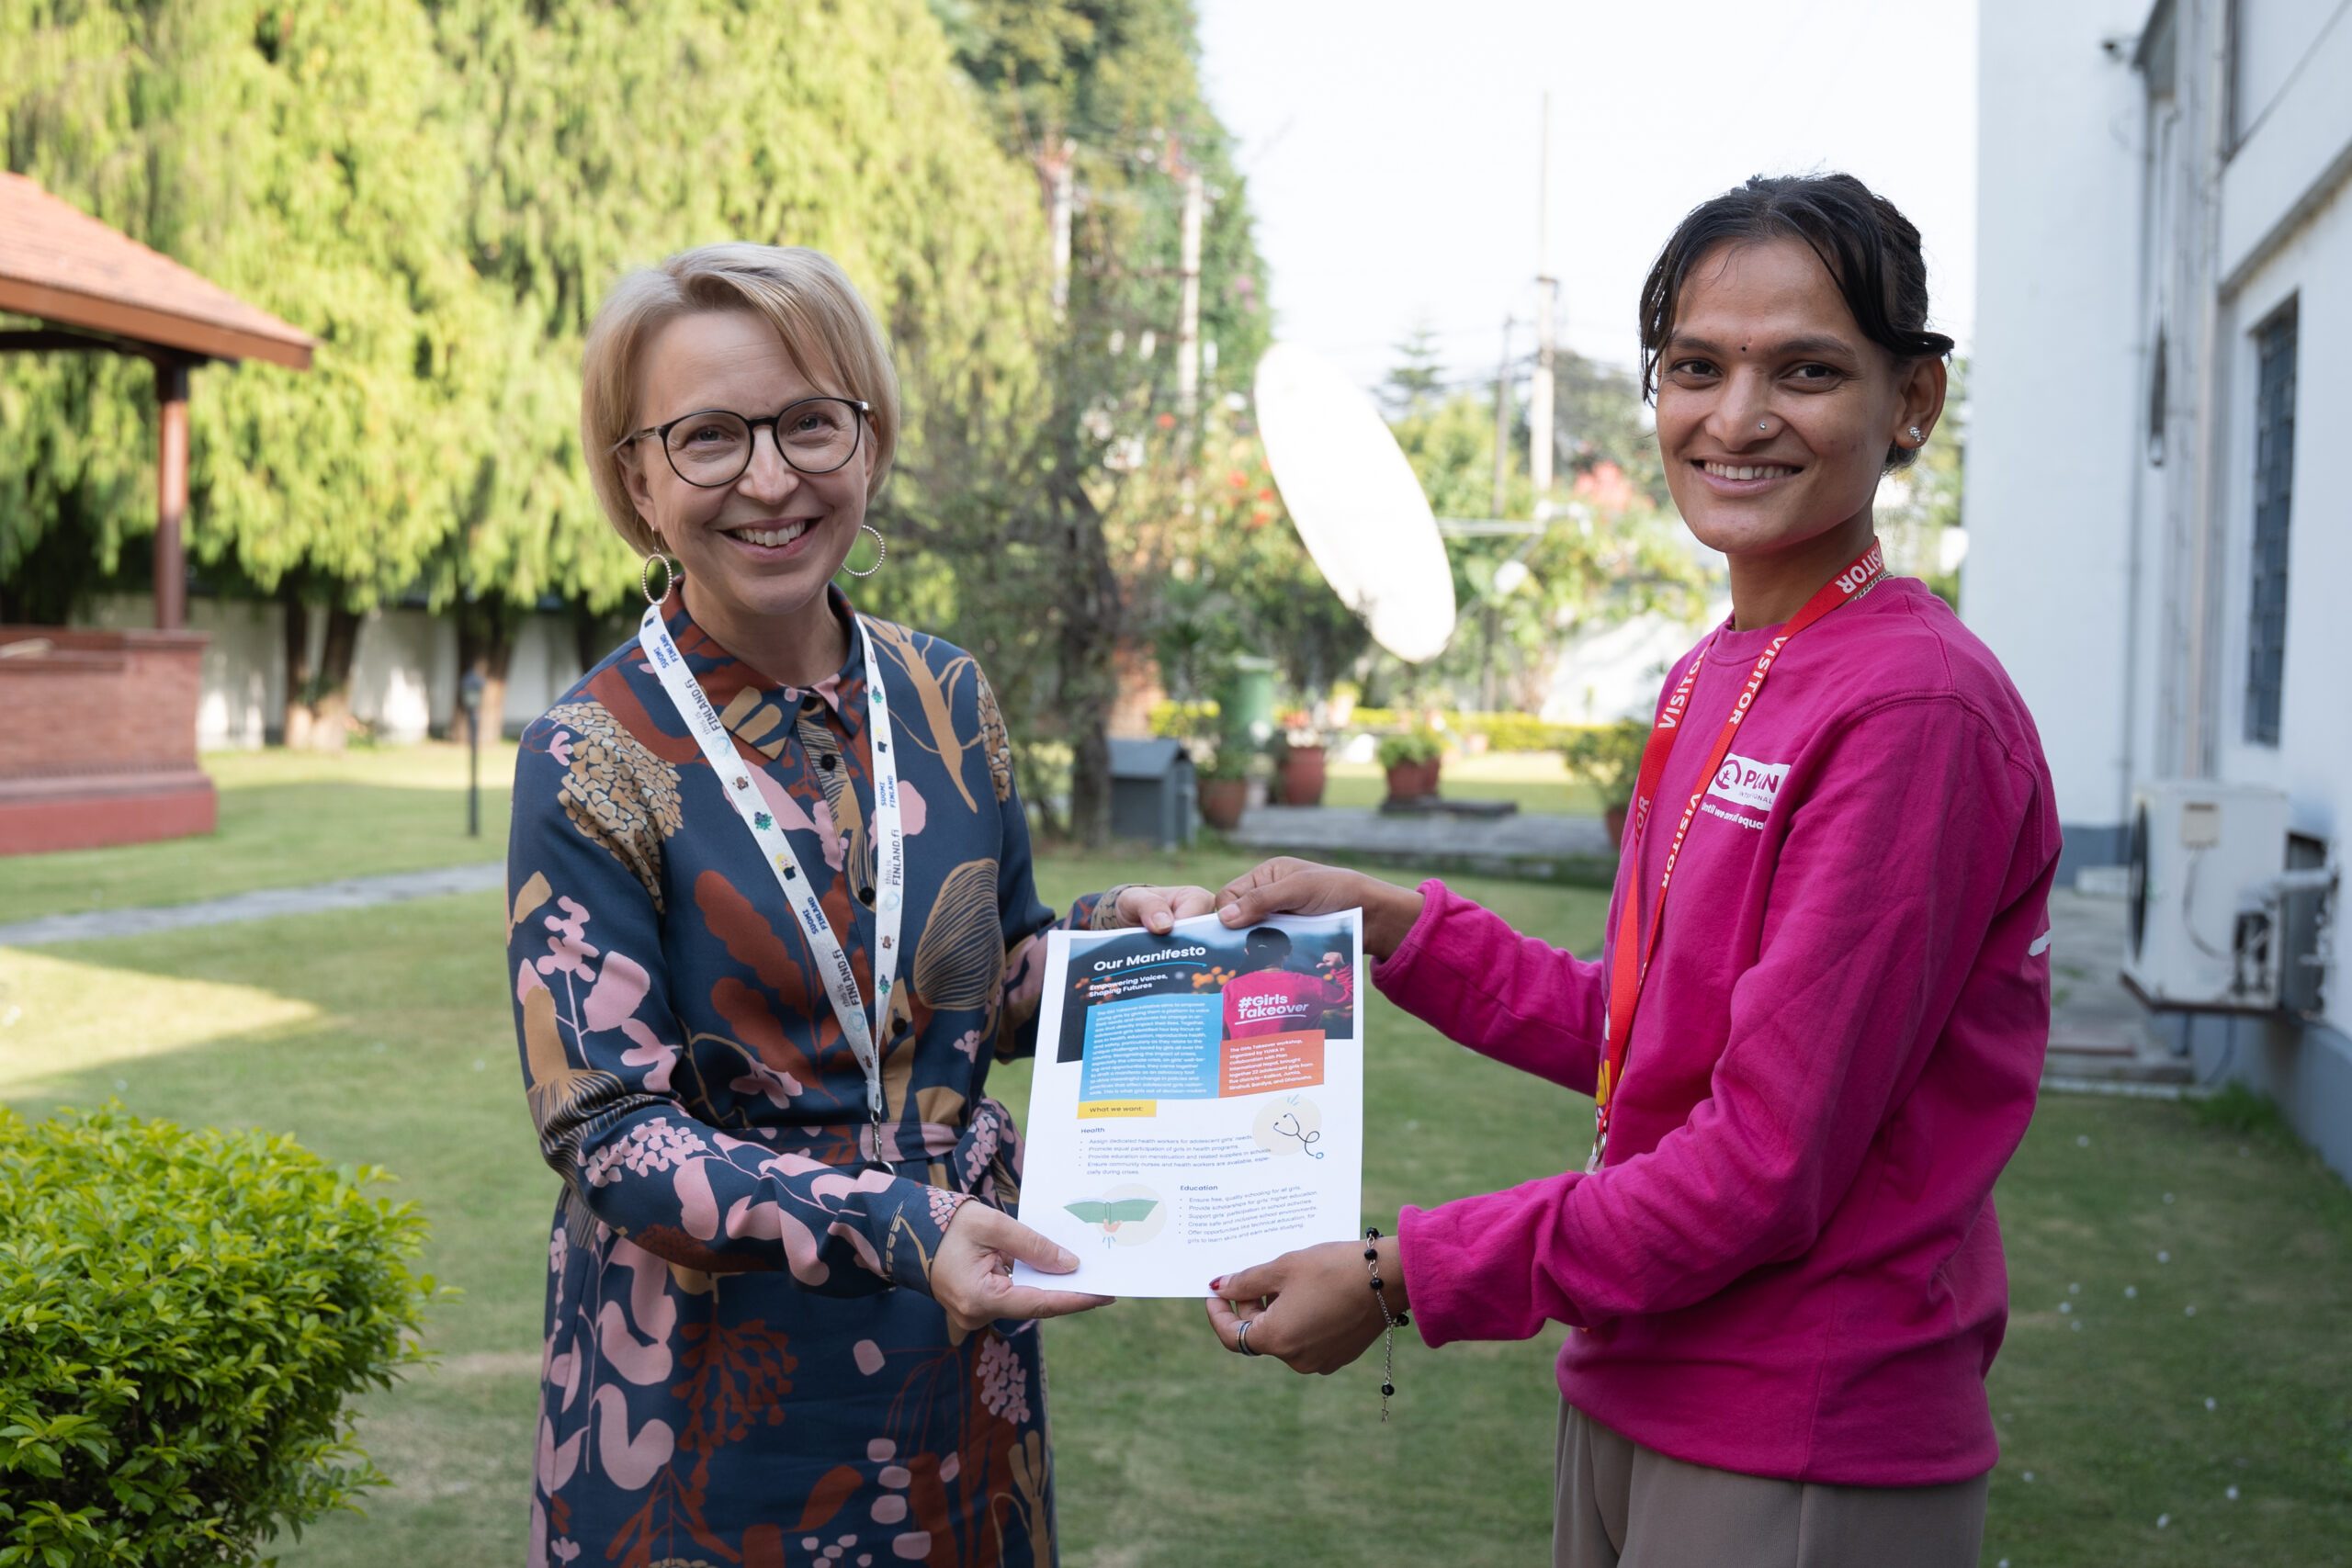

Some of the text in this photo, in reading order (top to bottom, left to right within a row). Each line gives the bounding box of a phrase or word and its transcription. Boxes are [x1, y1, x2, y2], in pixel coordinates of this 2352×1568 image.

[653, 648, 669, 669] SUOMI
[660, 634, 679, 662] FINLAND
[1729, 636, 1789, 725] VISITOR
[684, 678, 722, 732] FINLAND.fi
[888, 775, 896, 808] FINLAND
[1662, 793, 1702, 888] VISITOR
[891, 829, 901, 886] FINLAND.fi
[803, 909, 819, 935] SUOMI
[808, 897, 828, 930] FINLAND
[1094, 946, 1206, 971] Our Manifesto
[832, 949, 860, 1006] FINLAND.fi
[1089, 974, 1168, 991] Empowering Voices,
[1089, 982, 1153, 997] Shaping Futures
[1238, 994, 1288, 1008] #Girls
[1238, 1004, 1309, 1019] Takeover
